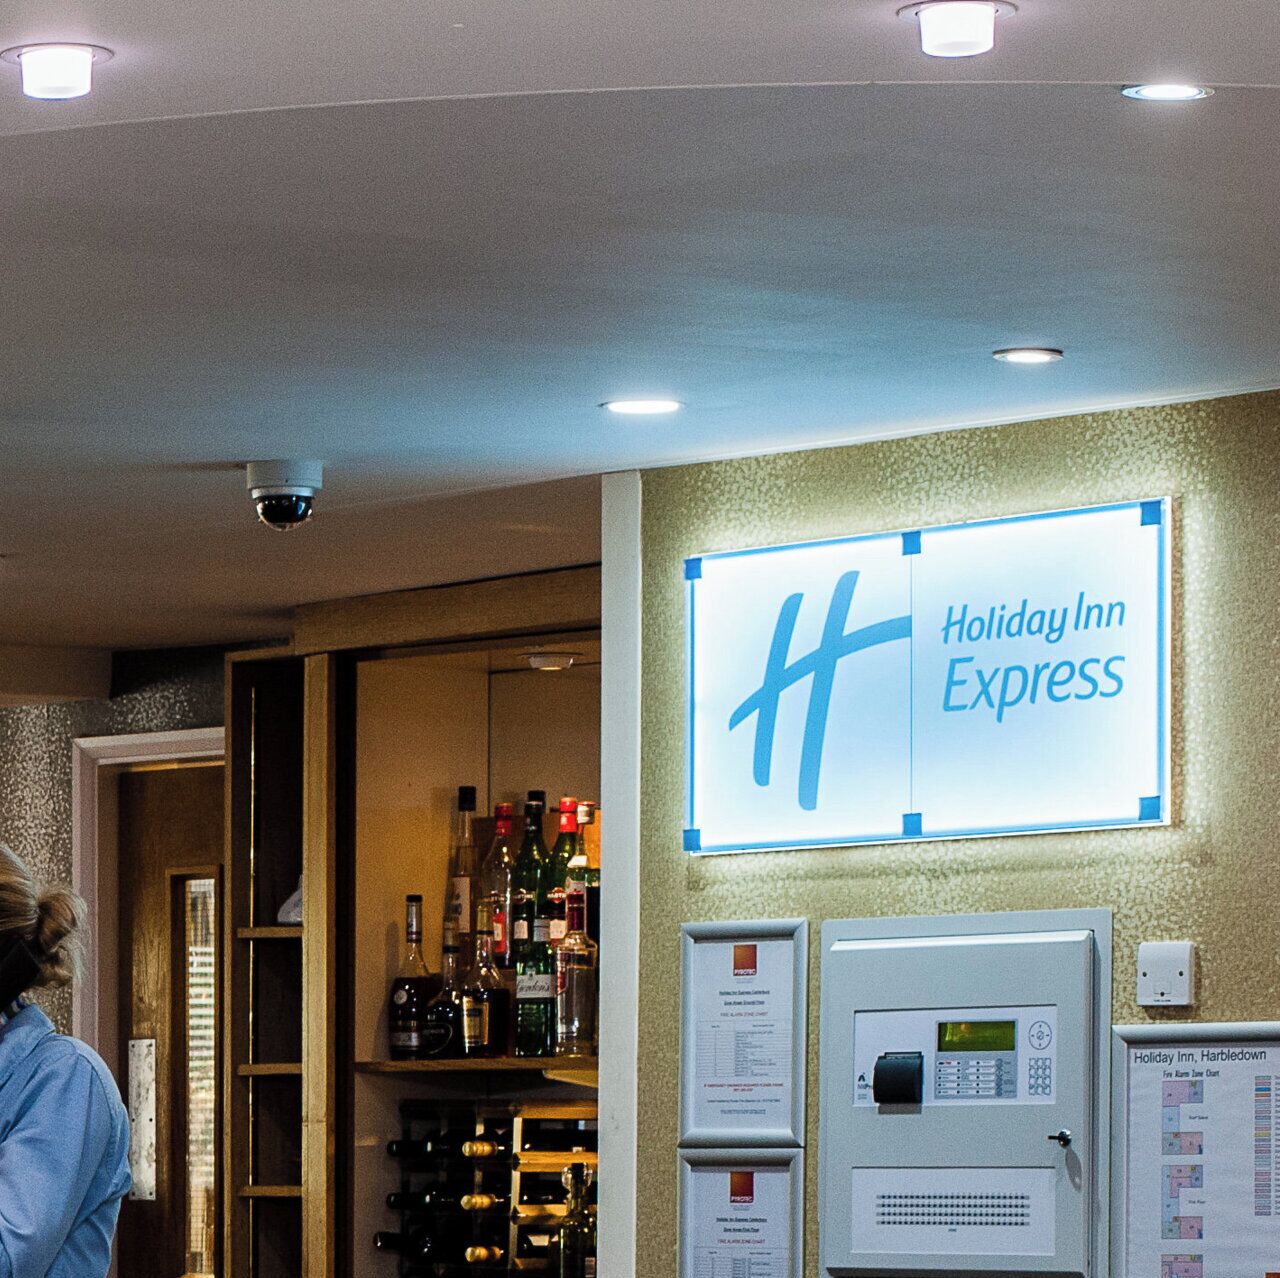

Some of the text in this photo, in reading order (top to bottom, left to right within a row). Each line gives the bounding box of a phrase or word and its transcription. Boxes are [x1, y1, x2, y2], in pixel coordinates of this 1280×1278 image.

[941, 592, 1126, 644] Holiday Inn
[942, 655, 1126, 724] Express
[1134, 1049, 1267, 1065] Holiday Inn, Harbledown
